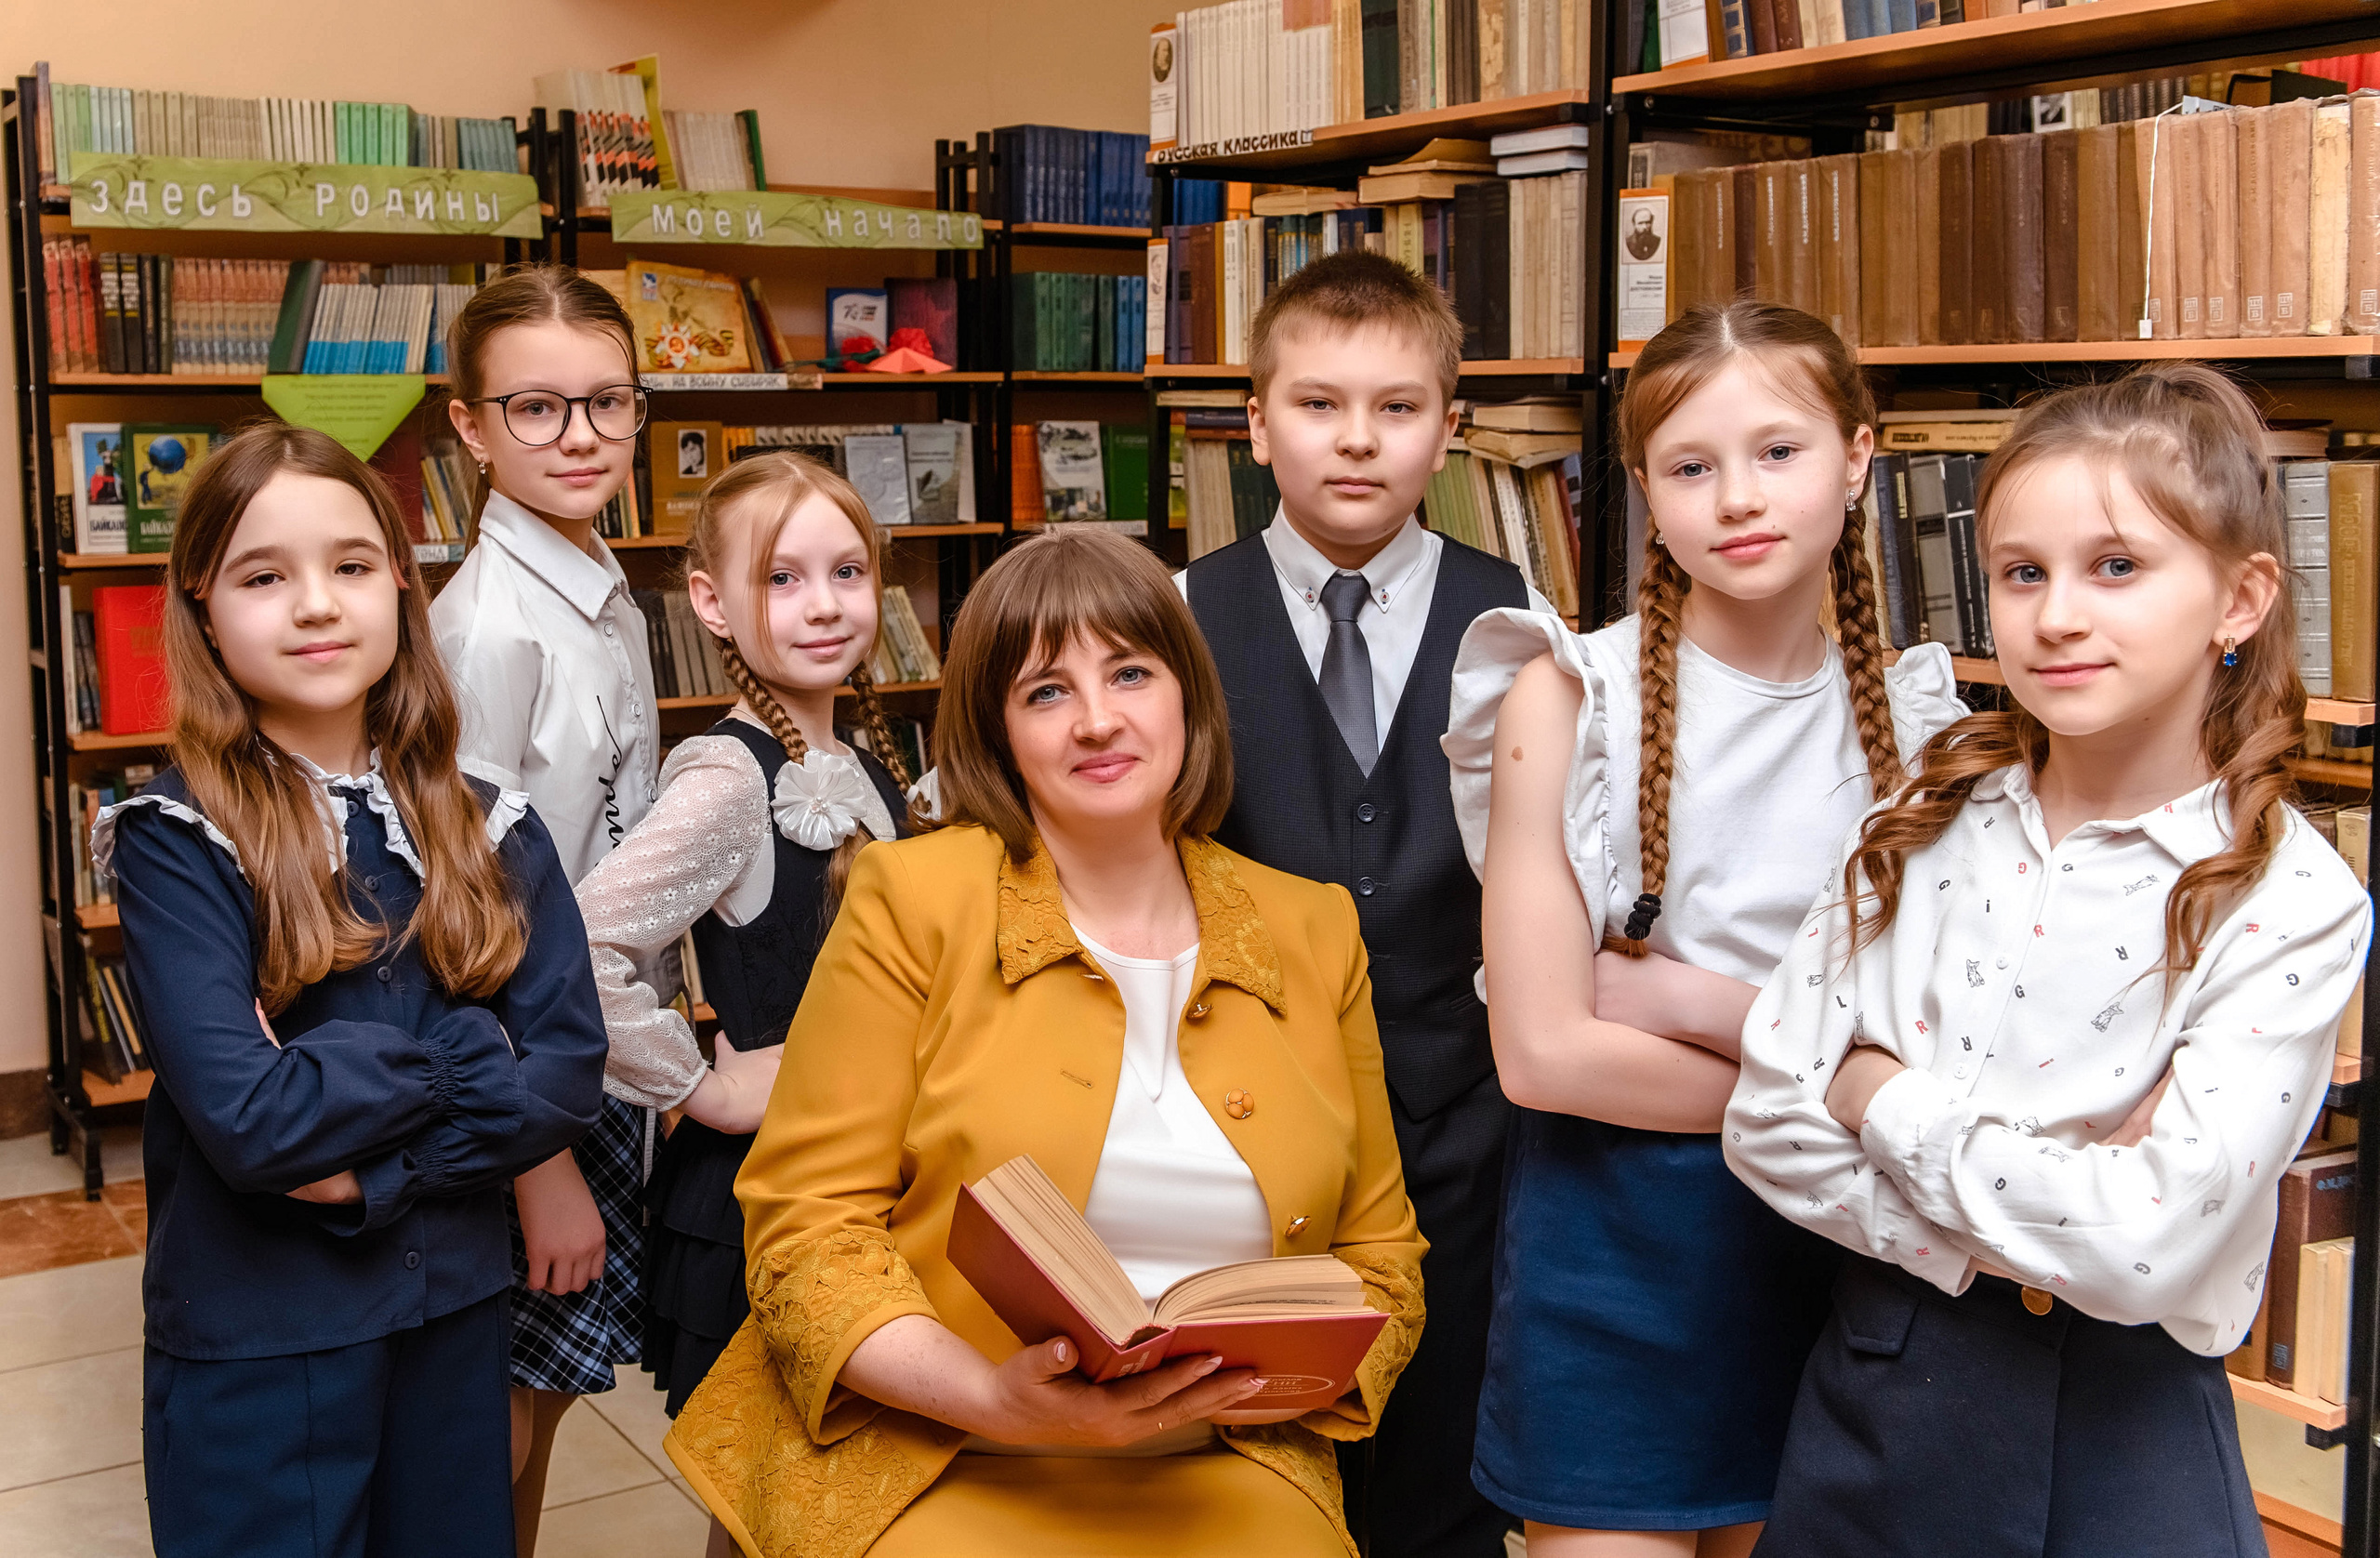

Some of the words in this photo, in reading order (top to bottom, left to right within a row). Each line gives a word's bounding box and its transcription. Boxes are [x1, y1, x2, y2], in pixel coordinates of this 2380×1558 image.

[2017, 862, 2028, 874] G
[2061, 863, 2074, 872] G
[1938, 879, 1950, 891] G
[2246, 922, 2259, 933] R
[2115, 945, 2129, 961] R
[2285, 972, 2300, 986] G
[2014, 984, 2026, 999] G
[1914, 1020, 1929, 1035] R
[1961, 1036, 1973, 1051] R
[1813, 1057, 1826, 1071] R
[2281, 1091, 2292, 1103] G
[1994, 1177, 2007, 1191] G
[1915, 1247, 1930, 1257] R
[2133, 1261, 2151, 1275] G
